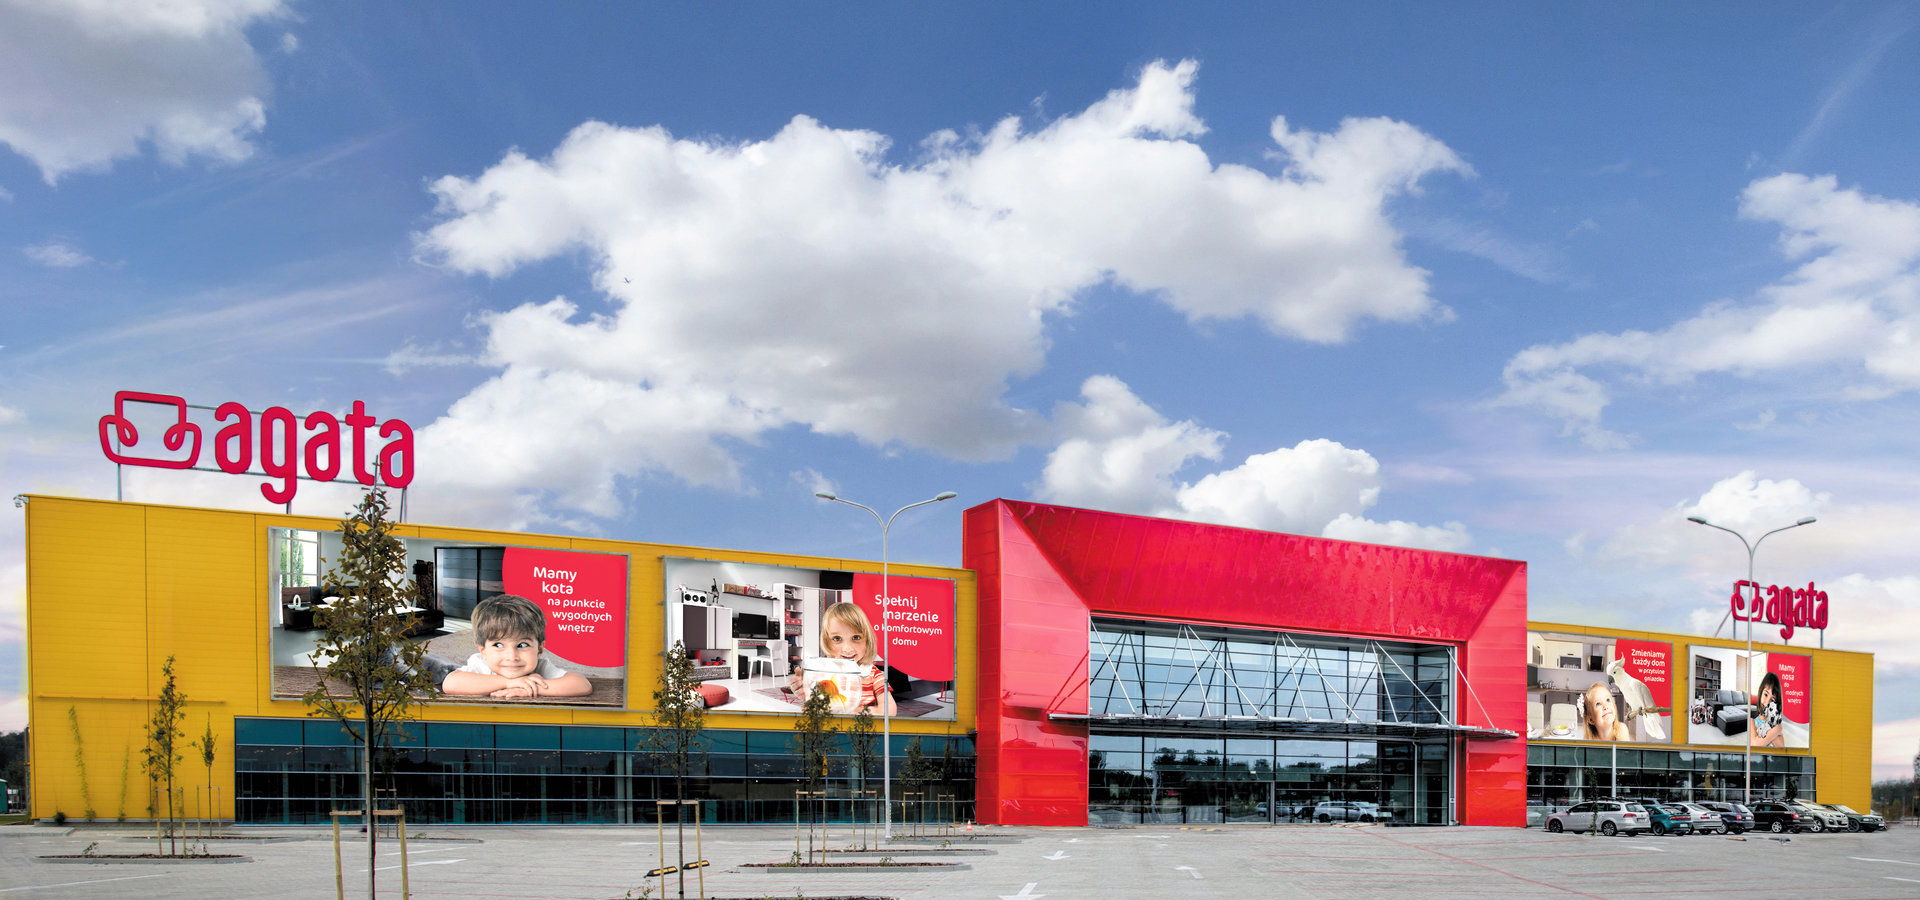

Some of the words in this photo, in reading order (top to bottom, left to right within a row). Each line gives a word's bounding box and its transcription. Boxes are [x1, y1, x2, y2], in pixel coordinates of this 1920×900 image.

[215, 400, 414, 504] agata
[533, 566, 577, 583] Mamy
[542, 581, 574, 595] kota
[547, 598, 561, 606] na
[563, 598, 606, 609] punkcie
[874, 594, 918, 610] Spełnij
[883, 610, 939, 622] marzenie
[1766, 581, 1829, 640] agata
[552, 611, 612, 623] wygodnych
[557, 623, 595, 634] wnętrz
[892, 637, 918, 647] domu
[1631, 648, 1665, 660] Zmieniamy
[1633, 657, 1650, 667] każdy
[1651, 659, 1665, 667] dom
[1778, 663, 1796, 673] Mamy
